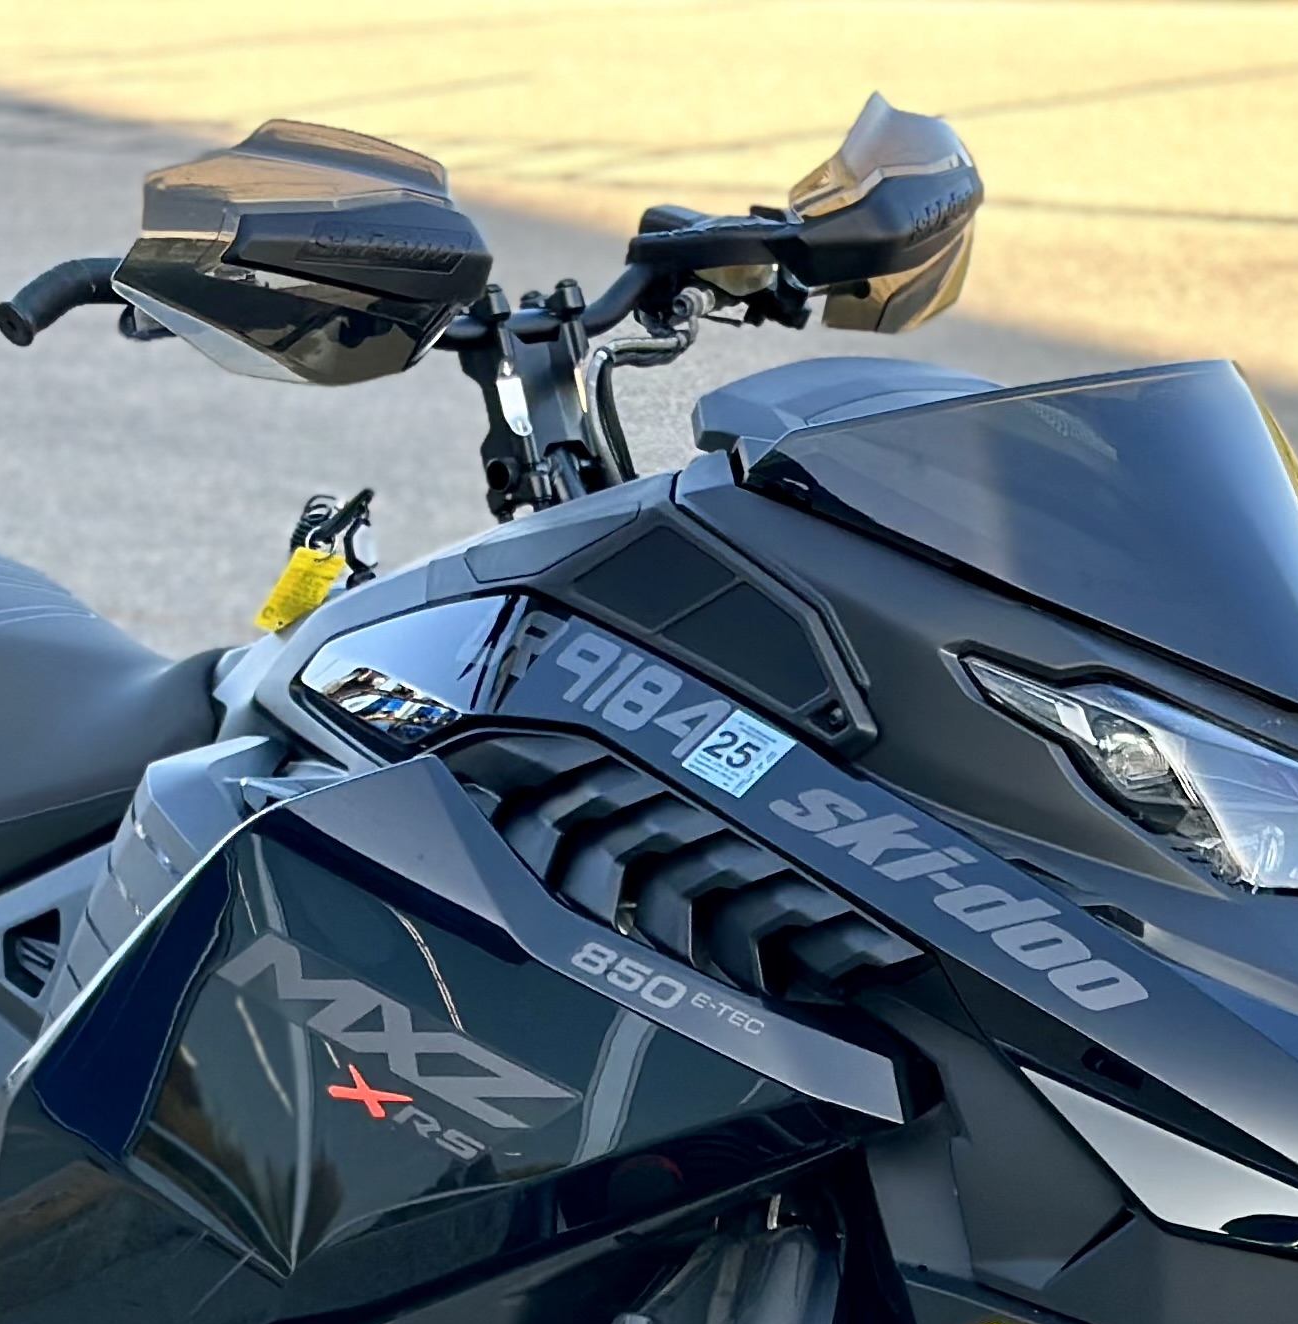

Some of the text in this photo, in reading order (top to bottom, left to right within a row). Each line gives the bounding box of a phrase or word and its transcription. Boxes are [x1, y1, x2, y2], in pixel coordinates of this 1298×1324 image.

[556, 632, 732, 759] 9184
[702, 730, 761, 769] 25
[215, 933, 581, 1130] MXZ
[571, 942, 766, 1036] 850 E-TEC
